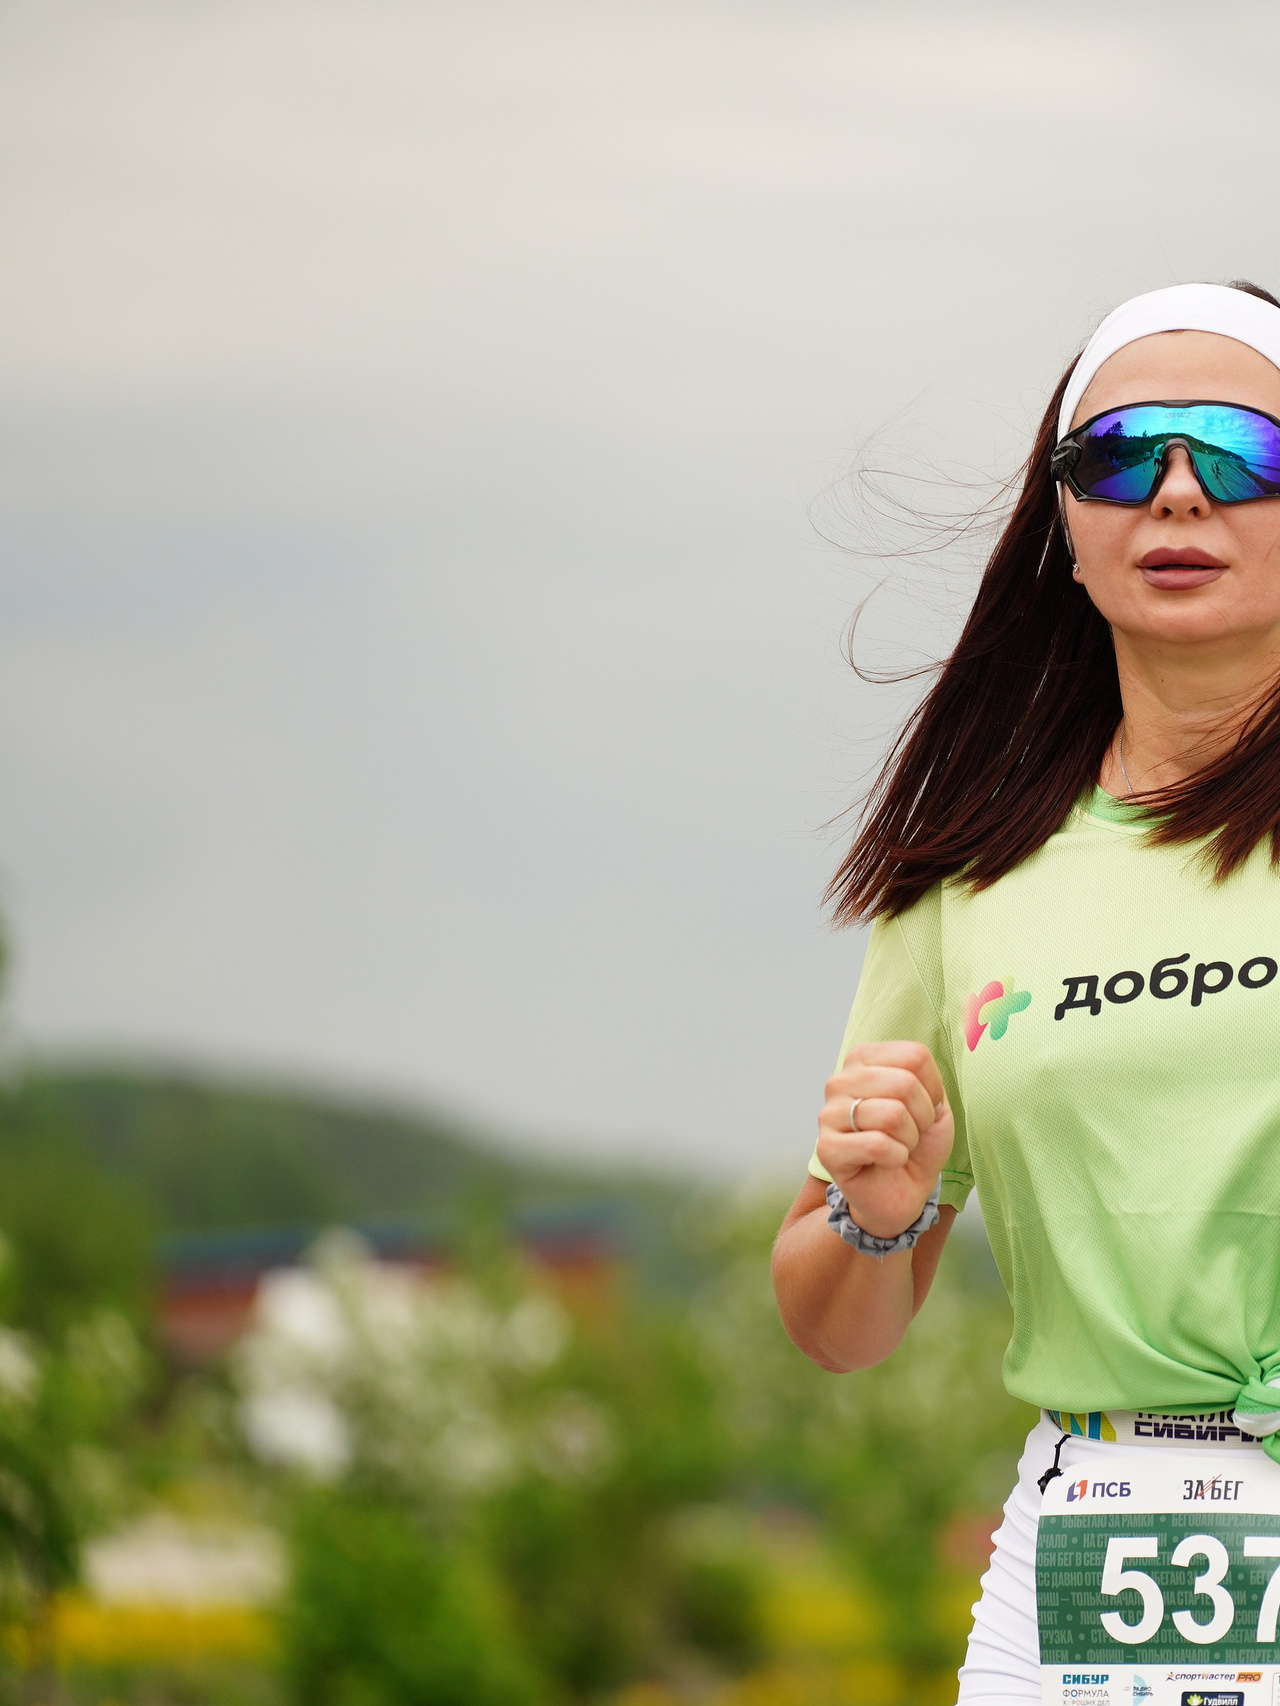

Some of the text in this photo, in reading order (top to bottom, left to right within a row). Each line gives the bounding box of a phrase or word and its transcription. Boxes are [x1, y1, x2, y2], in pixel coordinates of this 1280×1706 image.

[1092, 1481, 1131, 1498] ПСБ
[1062, 1674, 1109, 1685] СИБУР
[1062, 1689, 1109, 1698] ФОРМУЛА
[1203, 1697, 1239, 1706] Гудвилл
